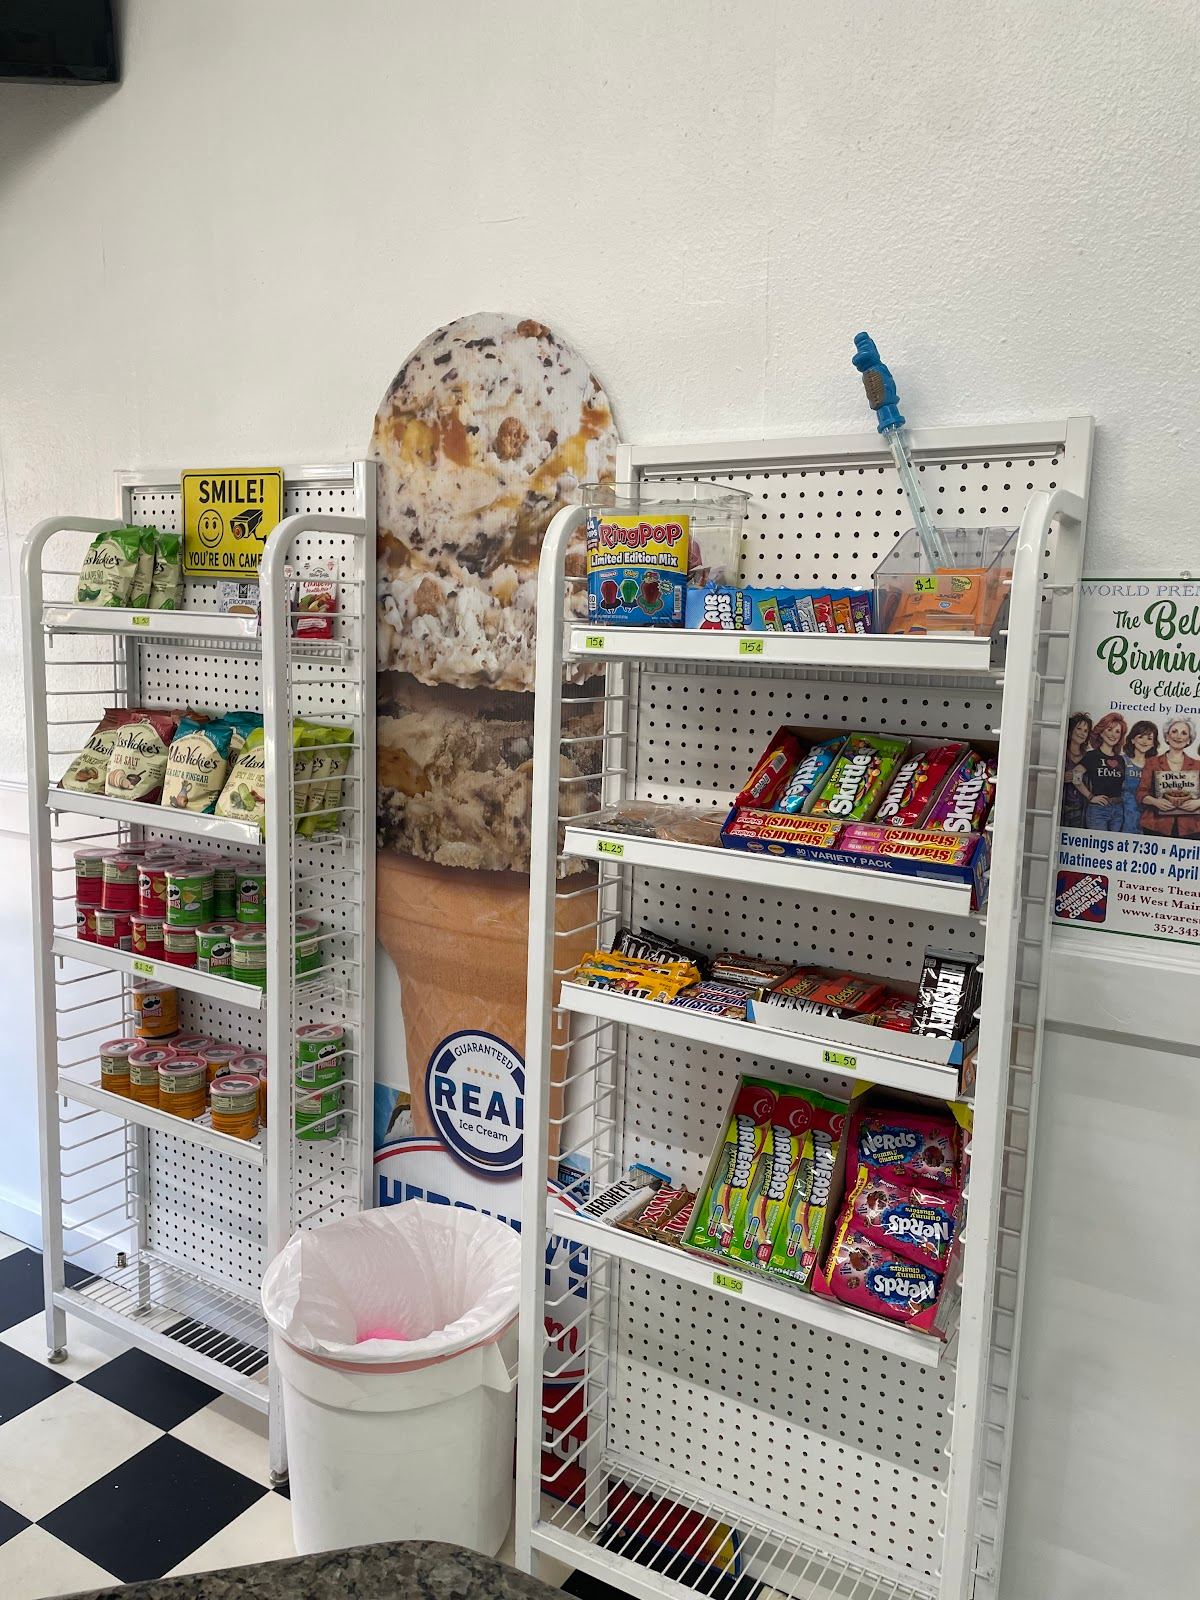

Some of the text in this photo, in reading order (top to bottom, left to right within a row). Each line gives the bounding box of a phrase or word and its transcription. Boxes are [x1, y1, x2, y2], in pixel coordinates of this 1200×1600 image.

[199, 479, 264, 503] SMILE!
[189, 552, 219, 566] YOU'RE
[222, 553, 235, 567] ON
[591, 552, 678, 567] Limited Edition Mix
[915, 578, 934, 591] $1
[1080, 585, 1150, 597] WORLD
[718, 594, 734, 630] EADS
[736, 592, 744, 614] bars
[1113, 610, 1140, 630] The
[1130, 679, 1151, 700] By
[1154, 680, 1192, 698] Eddie
[1110, 700, 1156, 712] Directed
[1160, 703, 1172, 715] by
[1098, 768, 1121, 778] Elvis
[1061, 832, 1200, 862] Evenings at 7:30 April
[810, 850, 857, 865] VARIETY
[860, 856, 893, 869] PACK
[1060, 852, 1198, 882] Matinees at 2:00 April
[1056, 876, 1092, 902] TAVARES
[1056, 876, 1102, 912] COMMUNITY
[1118, 880, 1164, 894] Tavares
[1065, 886, 1102, 912] THEATER
[1069, 889, 1106, 919] COMPANY
[1118, 892, 1136, 903] 904
[1140, 896, 1168, 908] West
[454, 1042, 514, 1070] GUARANTEED
[459, 1119, 509, 1142] Ice Cream
[736, 1114, 756, 1189] AIRHEADS
[768, 1125, 792, 1200] AIRHEADS
[810, 1130, 834, 1206] AIRHEADS
[584, 1180, 636, 1218] HERSHEY'S
